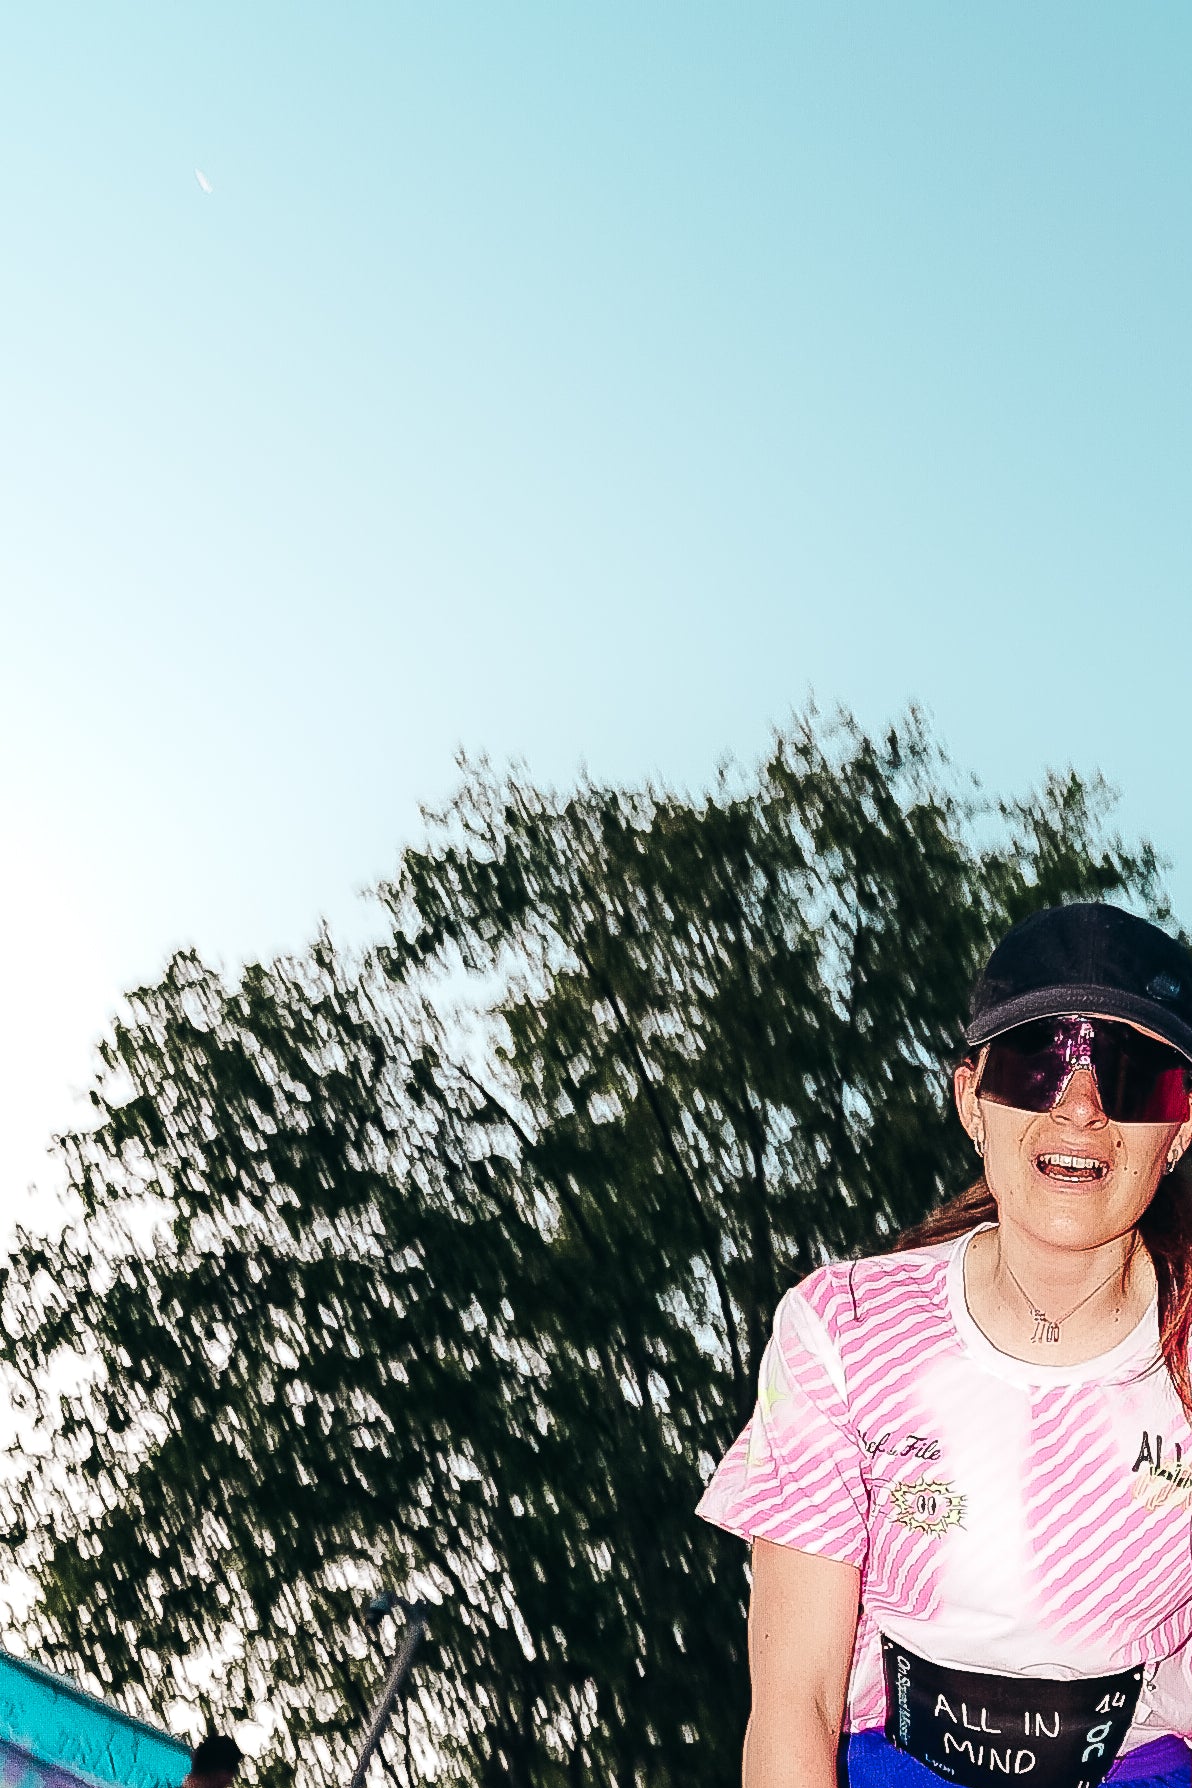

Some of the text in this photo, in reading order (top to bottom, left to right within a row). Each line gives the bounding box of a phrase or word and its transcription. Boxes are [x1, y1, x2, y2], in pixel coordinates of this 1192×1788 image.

[934, 1693, 1002, 1735] ALL
[1024, 1711, 1061, 1739] IN
[1095, 1691, 1126, 1714] 14
[943, 1732, 1037, 1775] MIND
